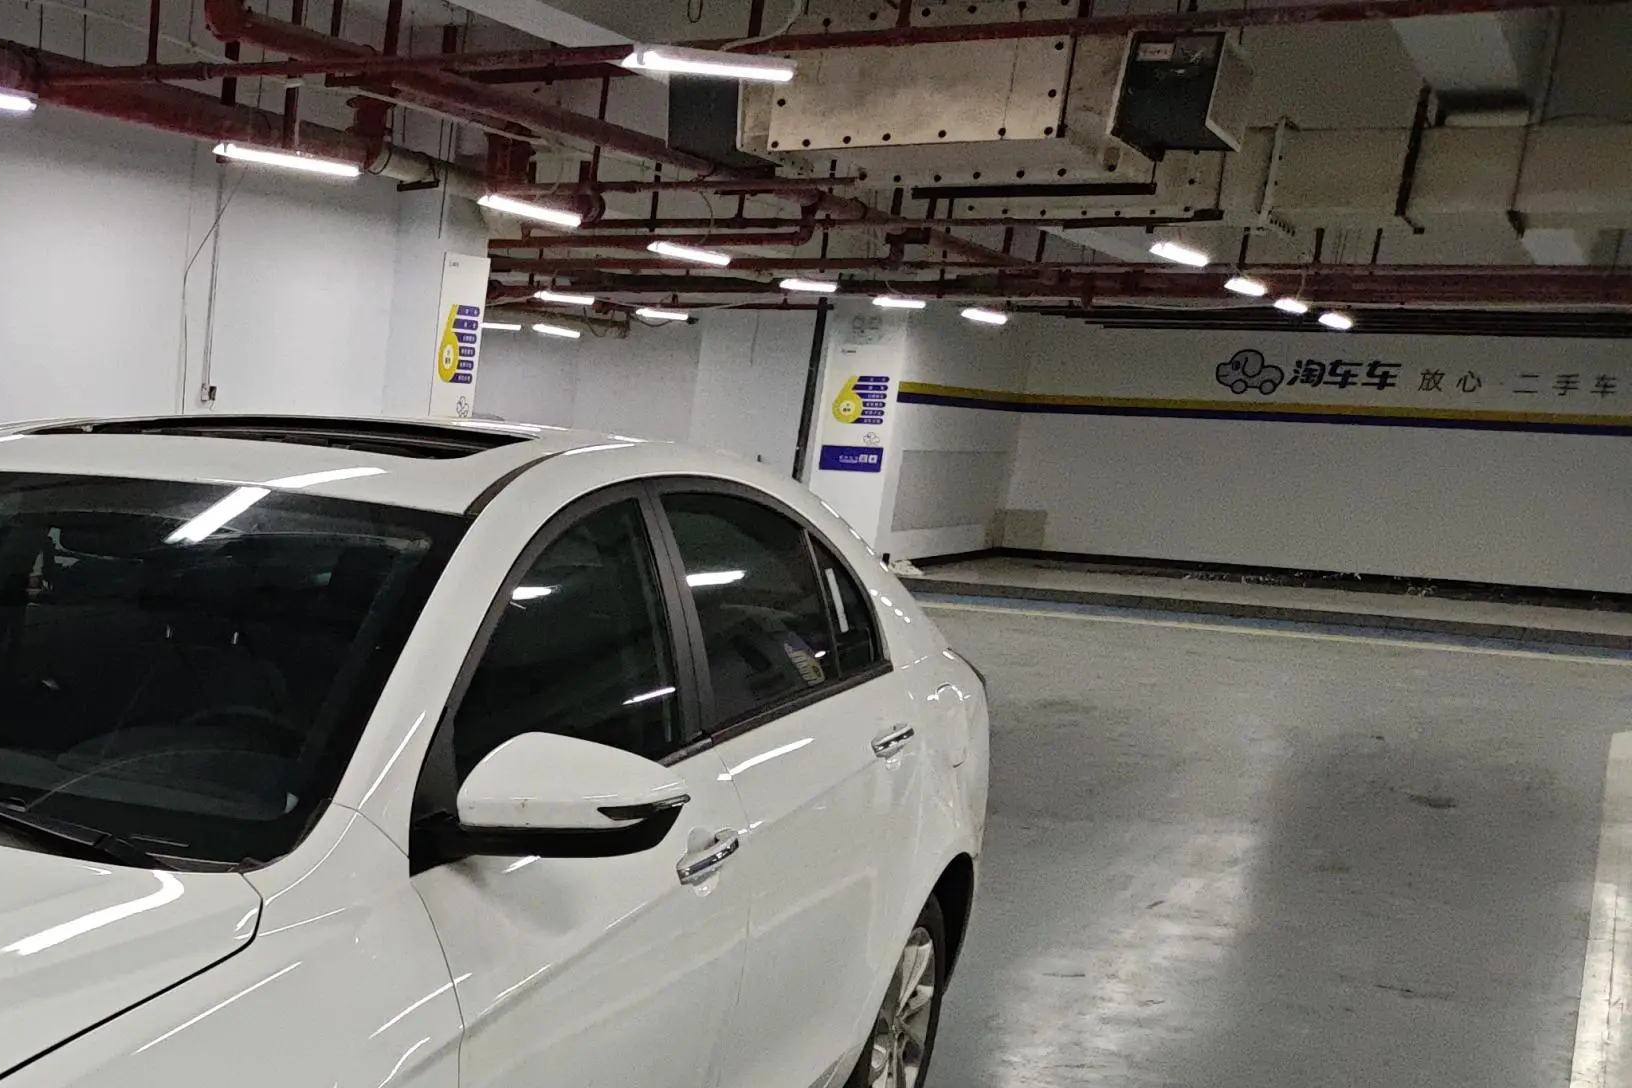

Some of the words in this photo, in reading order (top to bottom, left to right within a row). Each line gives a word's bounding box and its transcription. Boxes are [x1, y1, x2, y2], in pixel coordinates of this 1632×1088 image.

[1287, 359, 1402, 390] 淘车车
[1418, 369, 1482, 394] 放心
[1513, 373, 1618, 399] 二手车
